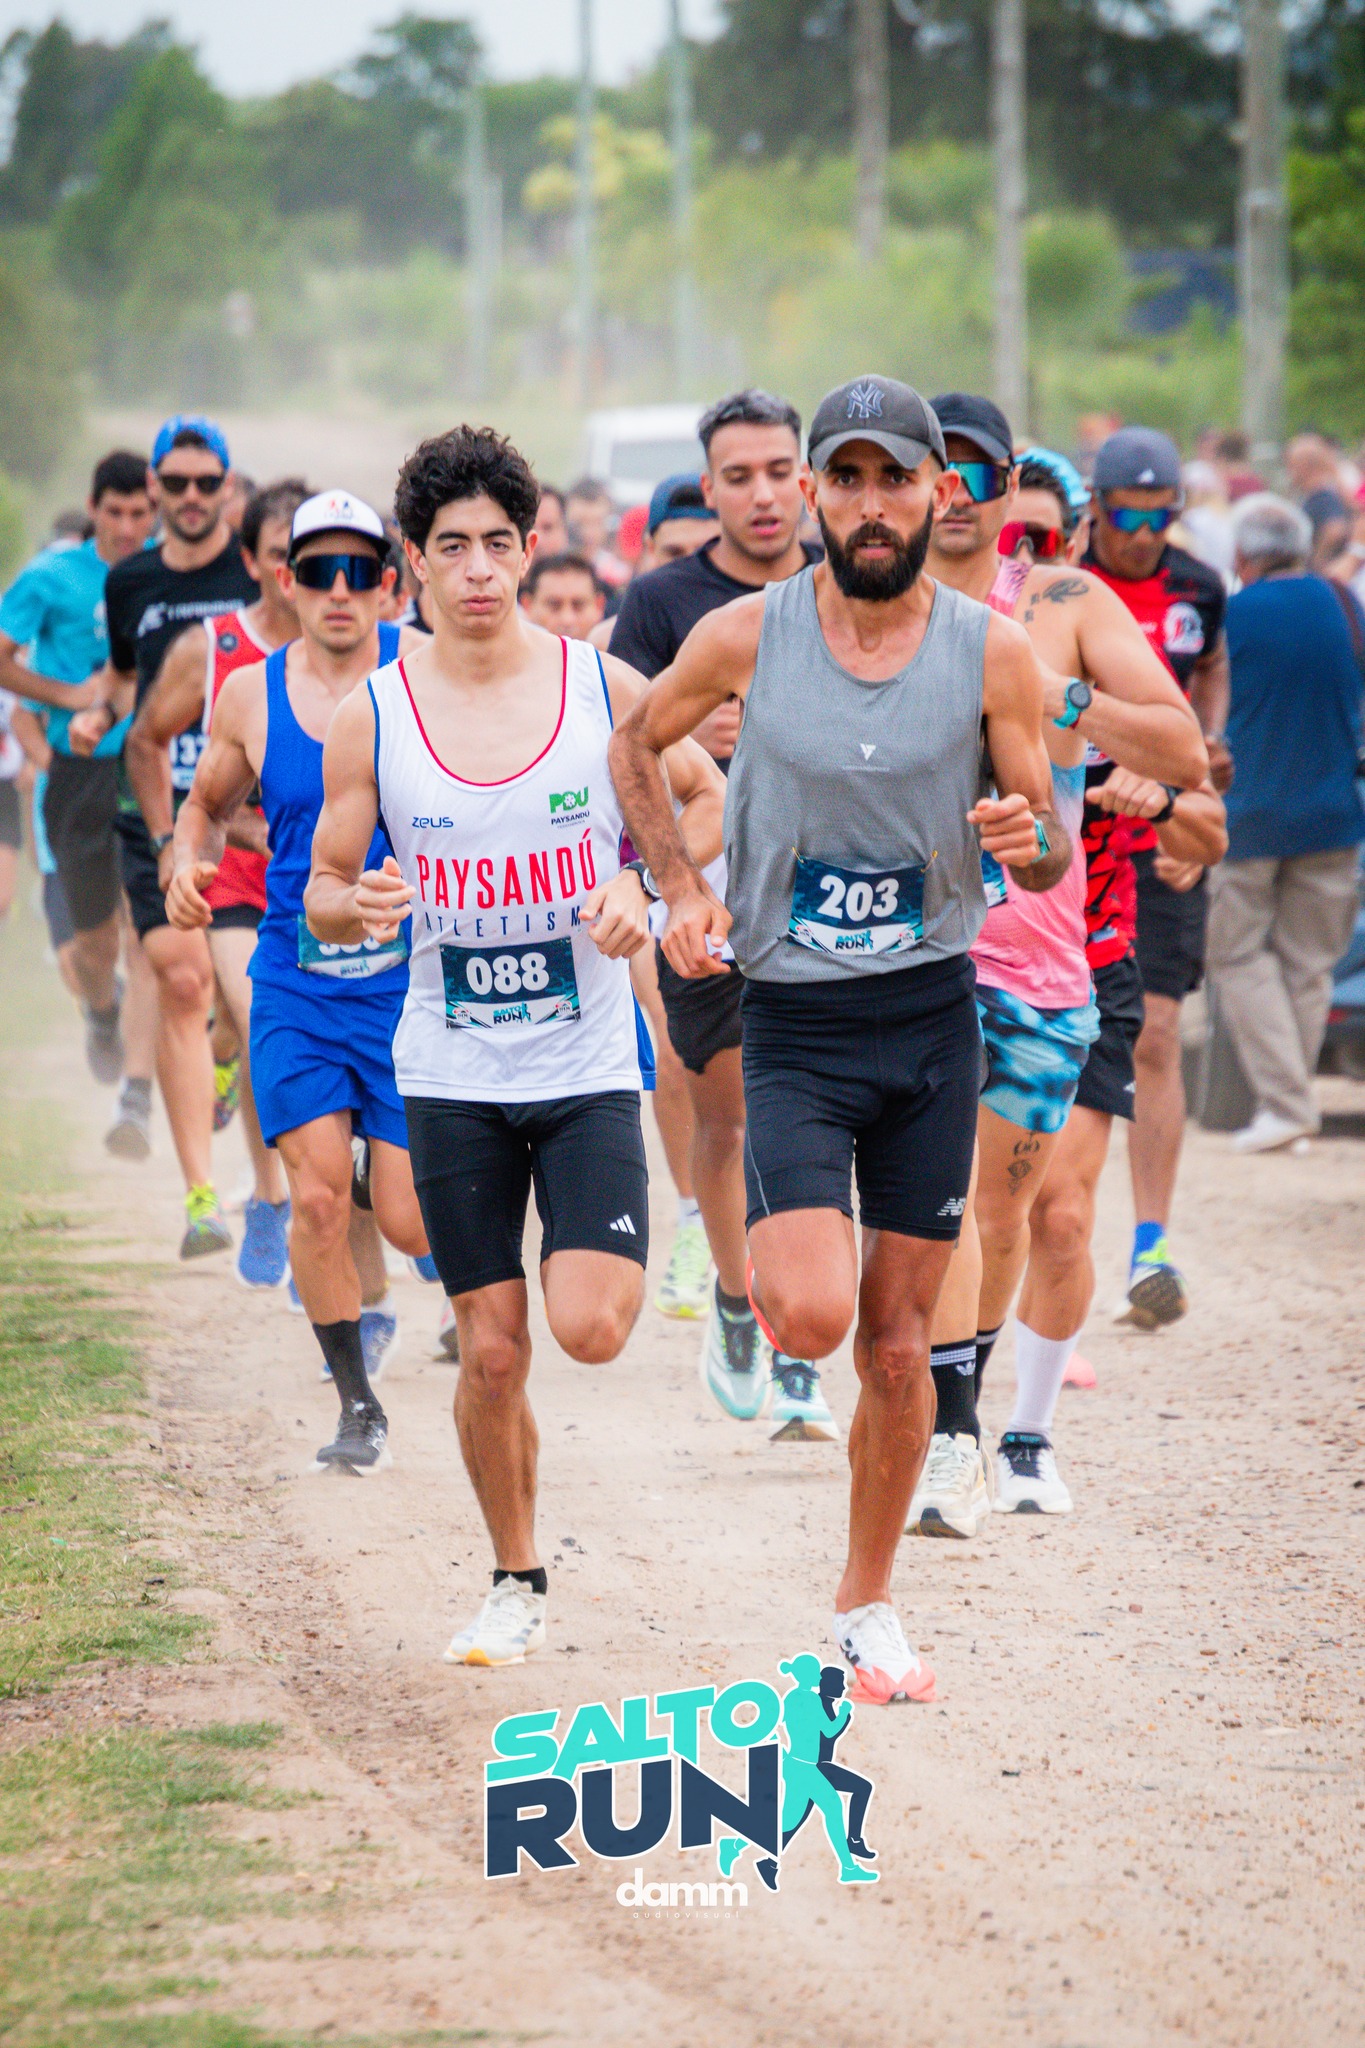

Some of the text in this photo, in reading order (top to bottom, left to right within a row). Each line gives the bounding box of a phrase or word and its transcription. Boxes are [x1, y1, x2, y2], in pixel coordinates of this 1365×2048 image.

[847, 383, 885, 418] NY
[416, 827, 597, 910] PAYSANDÚ
[817, 874, 899, 921] 203
[425, 905, 581, 937] ATLETISM
[835, 937, 865, 951] RUN
[466, 952, 549, 995] 088
[494, 1010, 522, 1024] RUN
